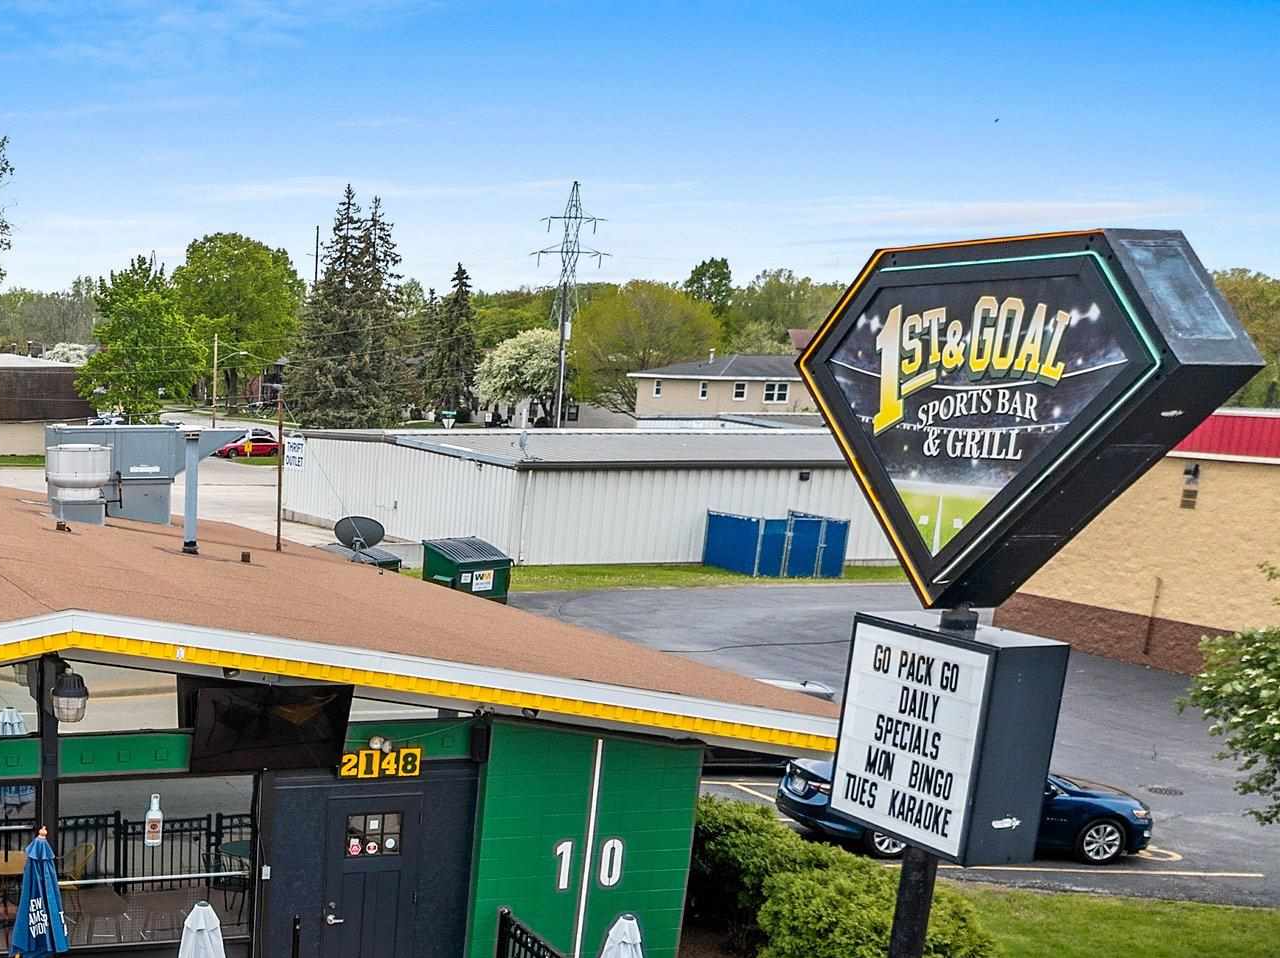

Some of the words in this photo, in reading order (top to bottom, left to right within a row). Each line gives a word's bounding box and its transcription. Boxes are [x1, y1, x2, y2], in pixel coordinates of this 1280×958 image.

[917, 388, 991, 429] SPORTS
[996, 388, 1038, 422] BAR
[923, 430, 941, 458] &
[947, 430, 1022, 460] GRILL
[873, 643, 891, 674] GO
[898, 650, 935, 687] PACK
[940, 661, 960, 693] GO
[898, 686, 940, 724] DAILY
[874, 714, 942, 761] SPECIALS
[340, 748, 421, 778] 2148
[864, 745, 896, 782] MON
[908, 760, 954, 801] BINGO
[844, 772, 878, 809] TUES
[888, 788, 953, 838] KARAOKE
